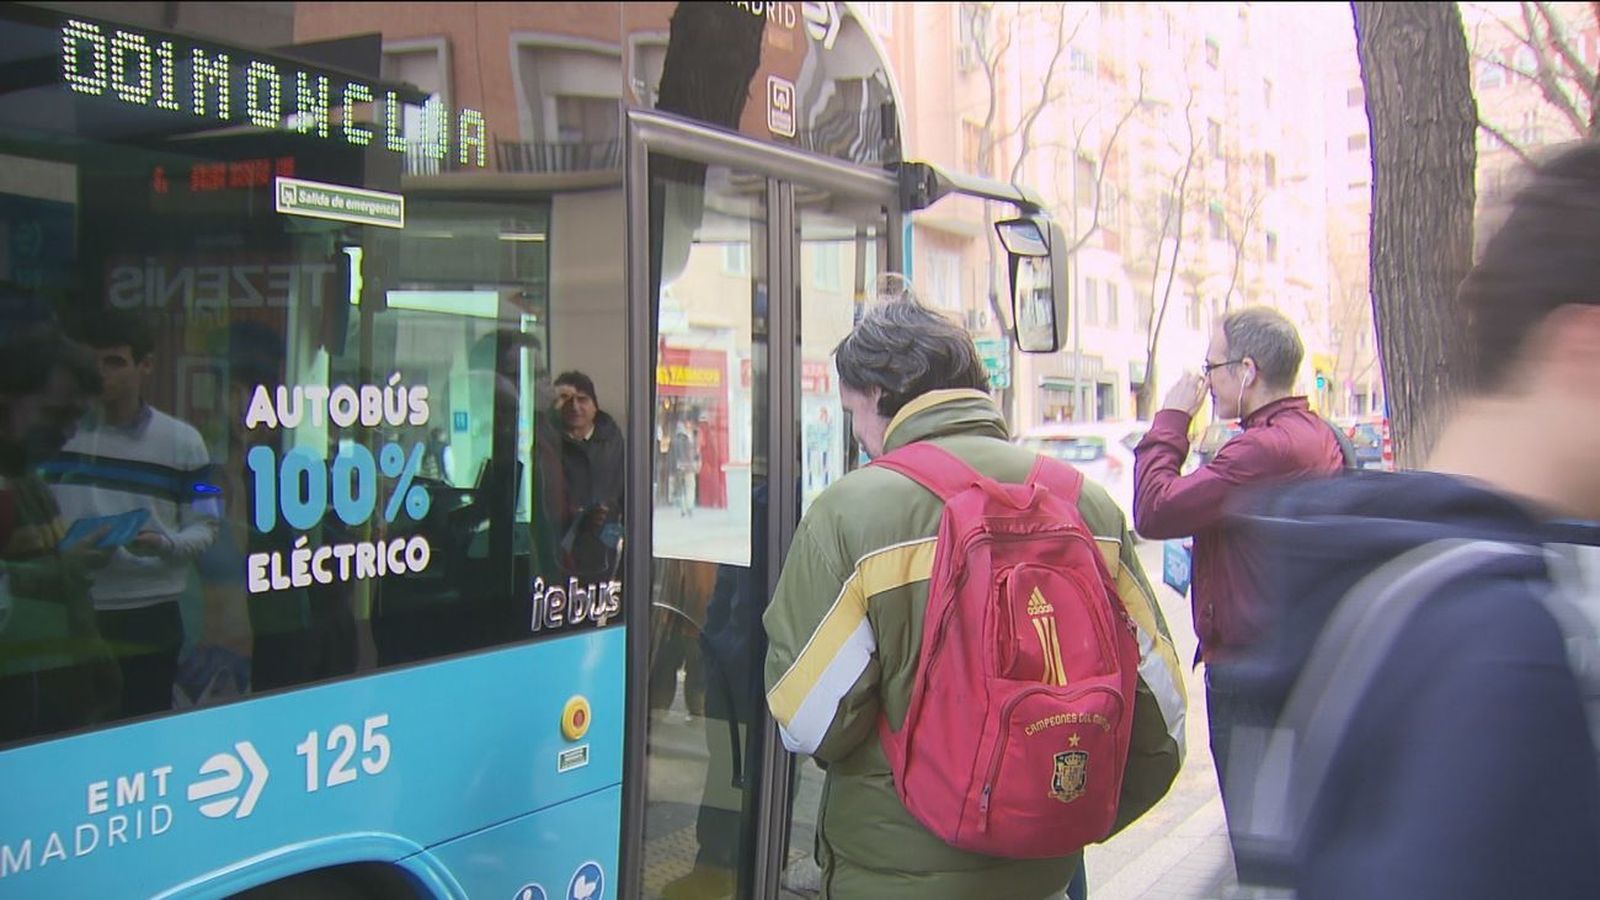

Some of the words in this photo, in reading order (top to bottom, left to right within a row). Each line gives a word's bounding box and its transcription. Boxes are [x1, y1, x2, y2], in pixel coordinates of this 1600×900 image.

[727, 2, 796, 29] DRID
[192, 47, 487, 168] MONCLOA
[298, 189, 330, 207] Salida
[331, 194, 345, 208] de
[345, 199, 400, 217] emergencia
[245, 372, 430, 429] AUTOBÚS
[247, 442, 430, 533] 100%
[247, 536, 431, 594] ELÉCTRICO
[1027, 603, 1054, 616] adidas
[1024, 712, 1077, 736] CAMPEONES
[296, 713, 391, 793] 125
[87, 765, 173, 814] EMT
[0, 804, 174, 878] MADRID
